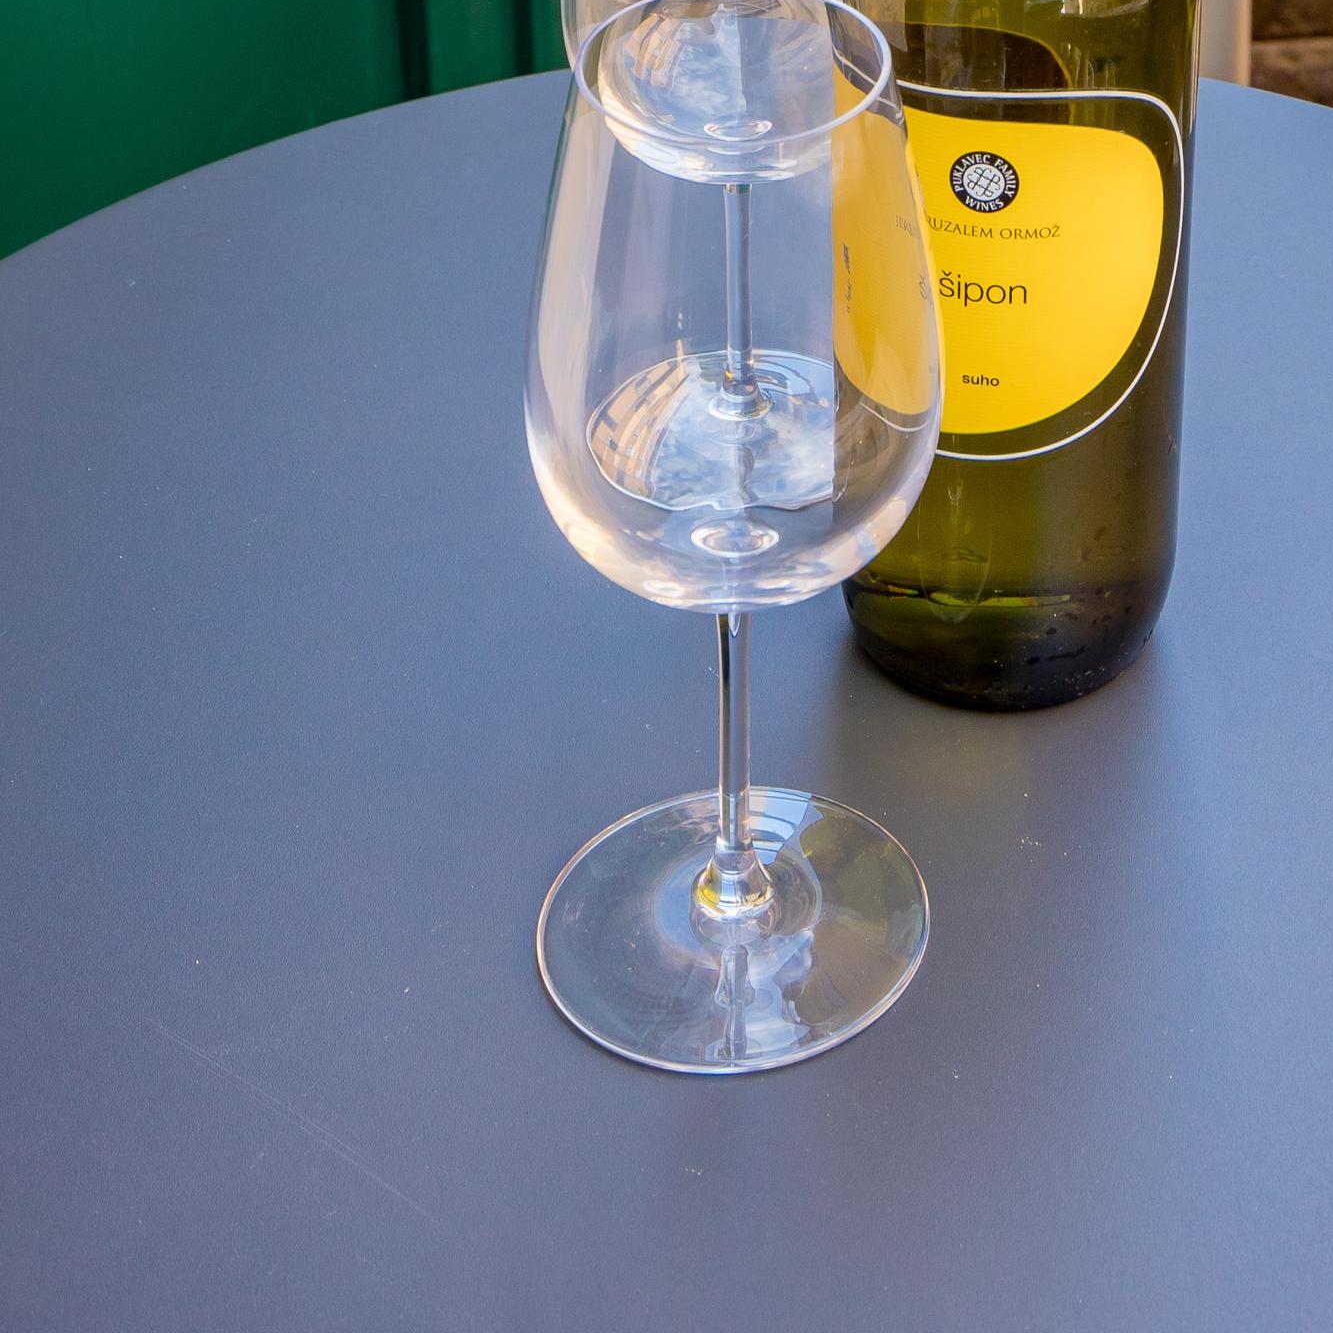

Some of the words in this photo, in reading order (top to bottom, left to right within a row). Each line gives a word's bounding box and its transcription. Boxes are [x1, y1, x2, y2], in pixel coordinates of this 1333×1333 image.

[953, 154, 991, 193] PUKLAVEC
[994, 158, 1017, 199] FAMILY
[965, 195, 1005, 212] WINES
[999, 224, 1061, 240] ORMOŽ
[939, 270, 1027, 307] šipon
[962, 374, 1000, 387] suho
